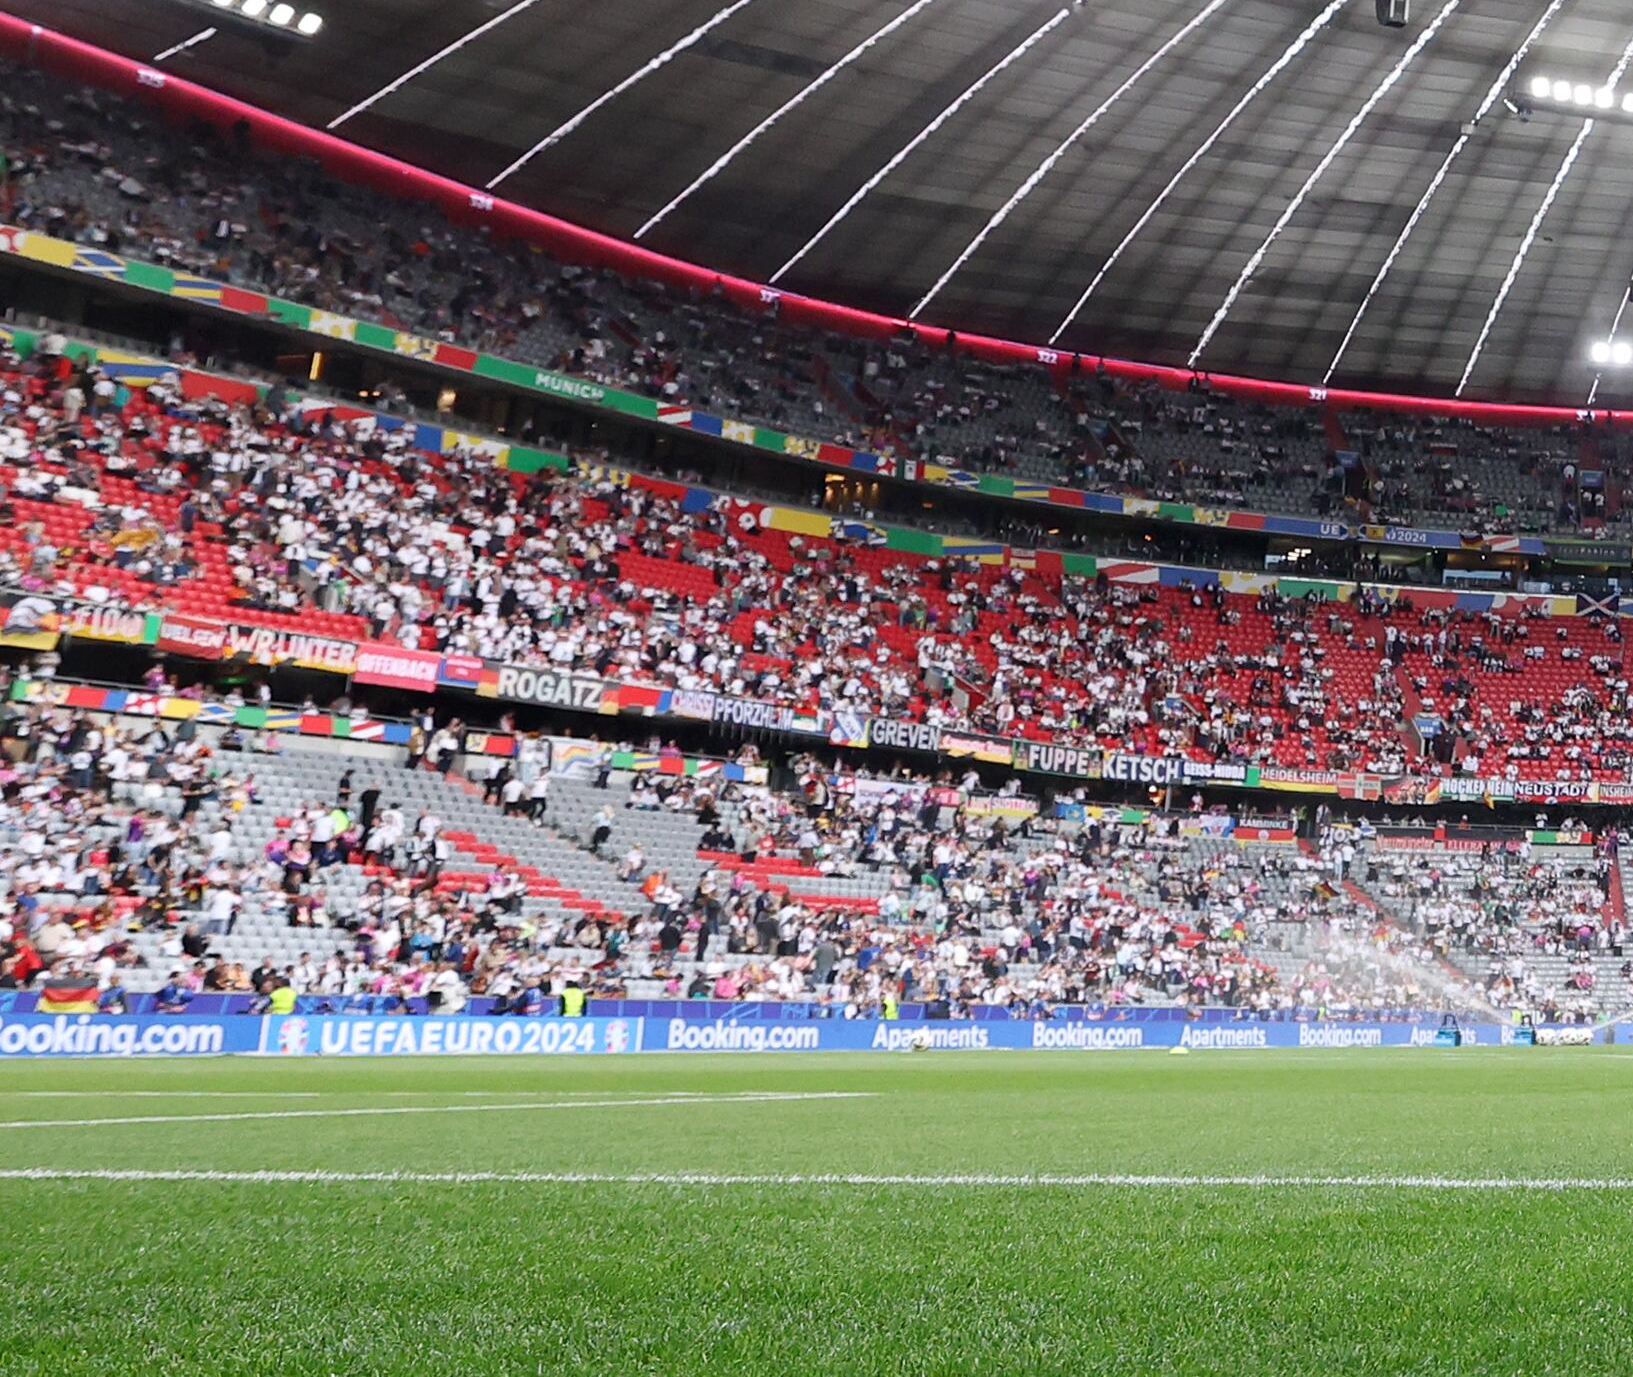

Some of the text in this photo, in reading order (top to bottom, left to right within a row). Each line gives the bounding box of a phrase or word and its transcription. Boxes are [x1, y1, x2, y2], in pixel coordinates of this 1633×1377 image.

[1037, 350, 1058, 365] 322
[1308, 387, 1327, 401] 321
[873, 719, 941, 751] GREVEN
[1029, 744, 1090, 775] FUPPE
[1102, 754, 1180, 784] KETSCH
[1260, 767, 1338, 785] HEIDELSHEIM
[0, 1015, 224, 1056] ooking.com
[669, 1018, 819, 1050] Booking.com
[1033, 1022, 1142, 1049] Booking.com
[1180, 1025, 1266, 1048] Apartments
[1299, 1023, 1382, 1047] Booking.com
